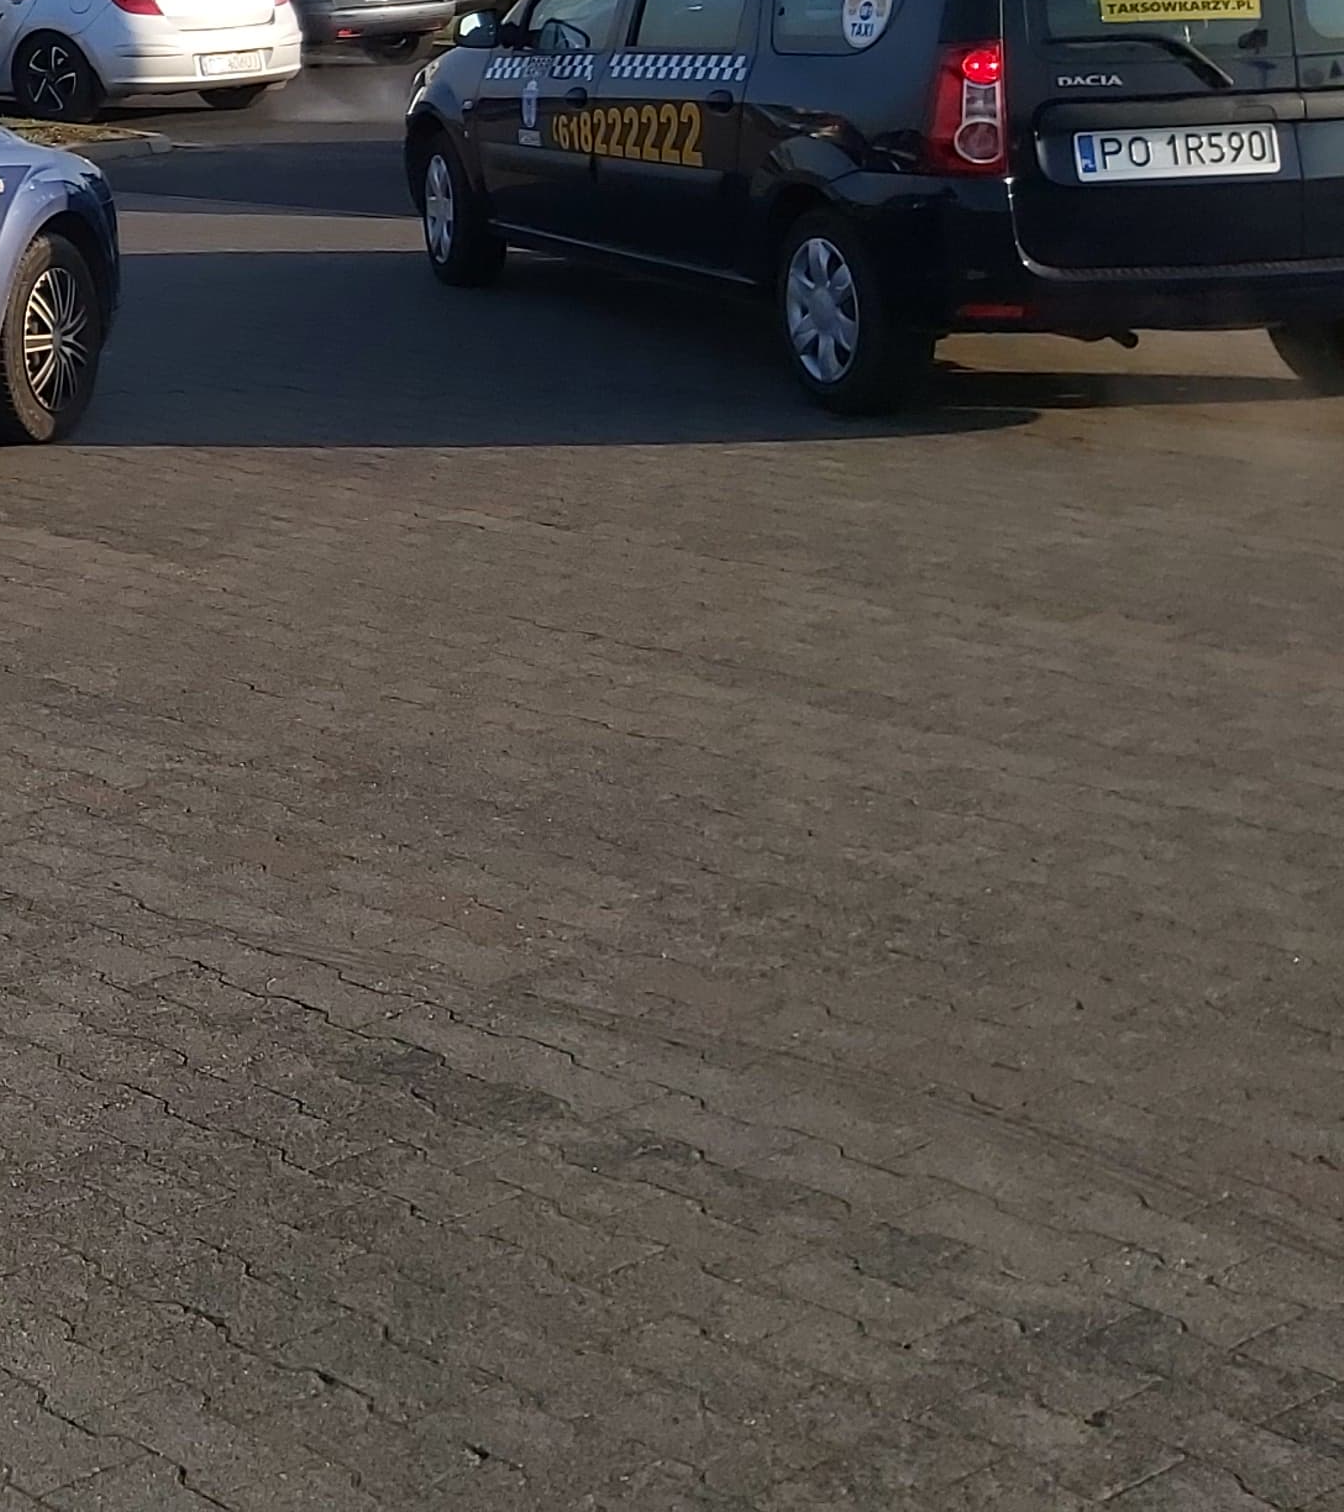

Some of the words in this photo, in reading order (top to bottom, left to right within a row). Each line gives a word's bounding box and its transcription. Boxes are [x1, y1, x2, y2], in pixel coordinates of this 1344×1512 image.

[1057, 74, 1123, 87] DACIA
[1100, 135, 1152, 170] PO
[1166, 129, 1268, 167] 1R590
